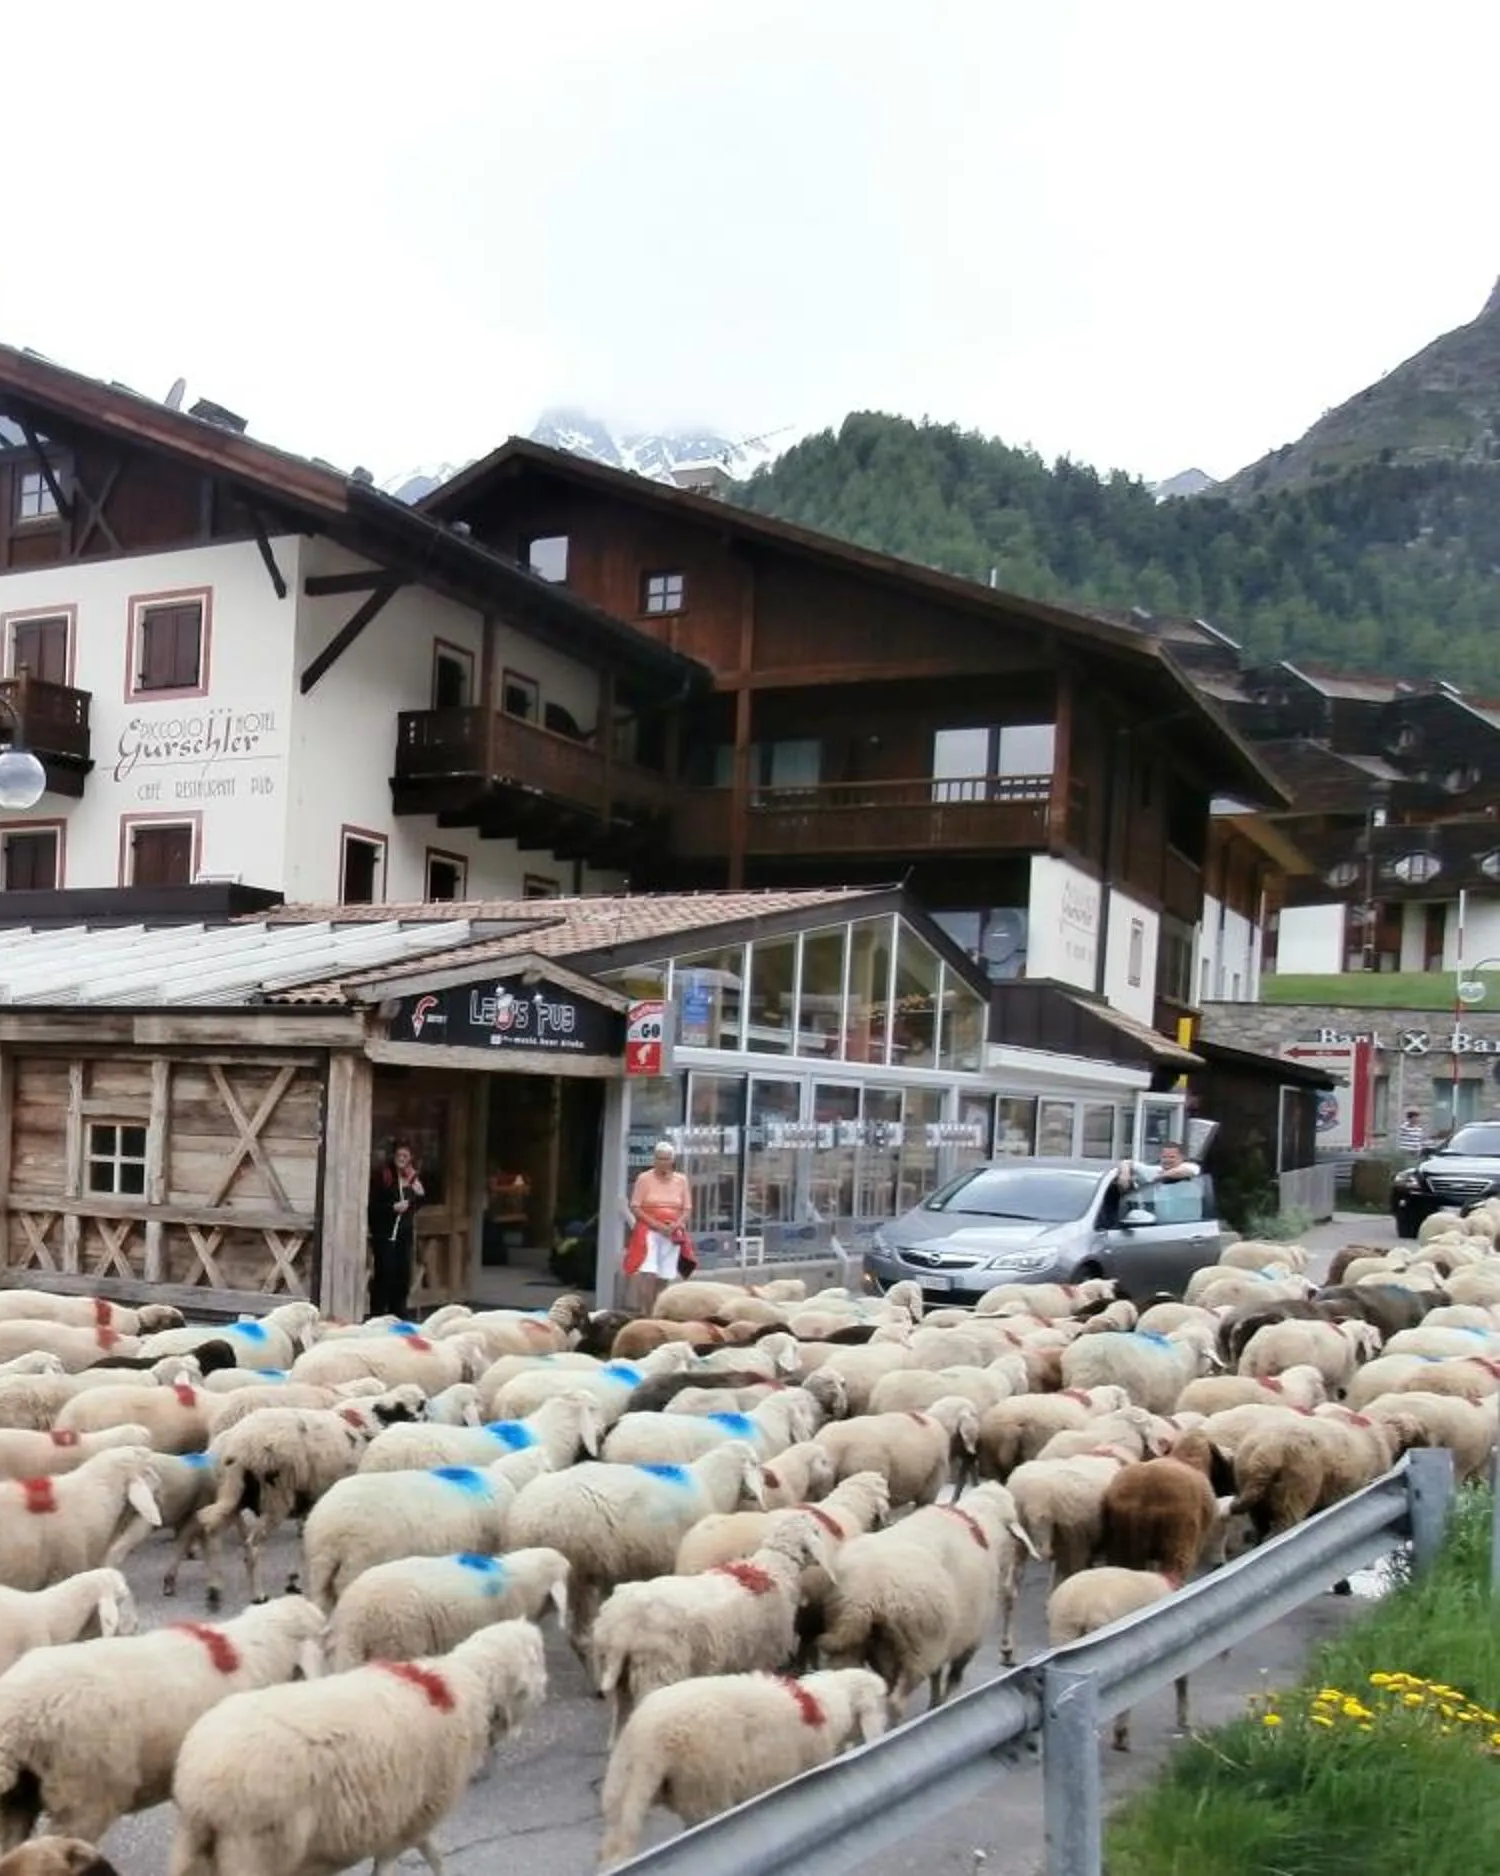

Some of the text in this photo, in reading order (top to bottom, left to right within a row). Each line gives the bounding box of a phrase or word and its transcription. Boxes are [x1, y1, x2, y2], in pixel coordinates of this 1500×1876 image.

[113, 716, 260, 783] Gurschler
[536, 1000, 575, 1036] PUB
[641, 1023, 661, 1038] GO
